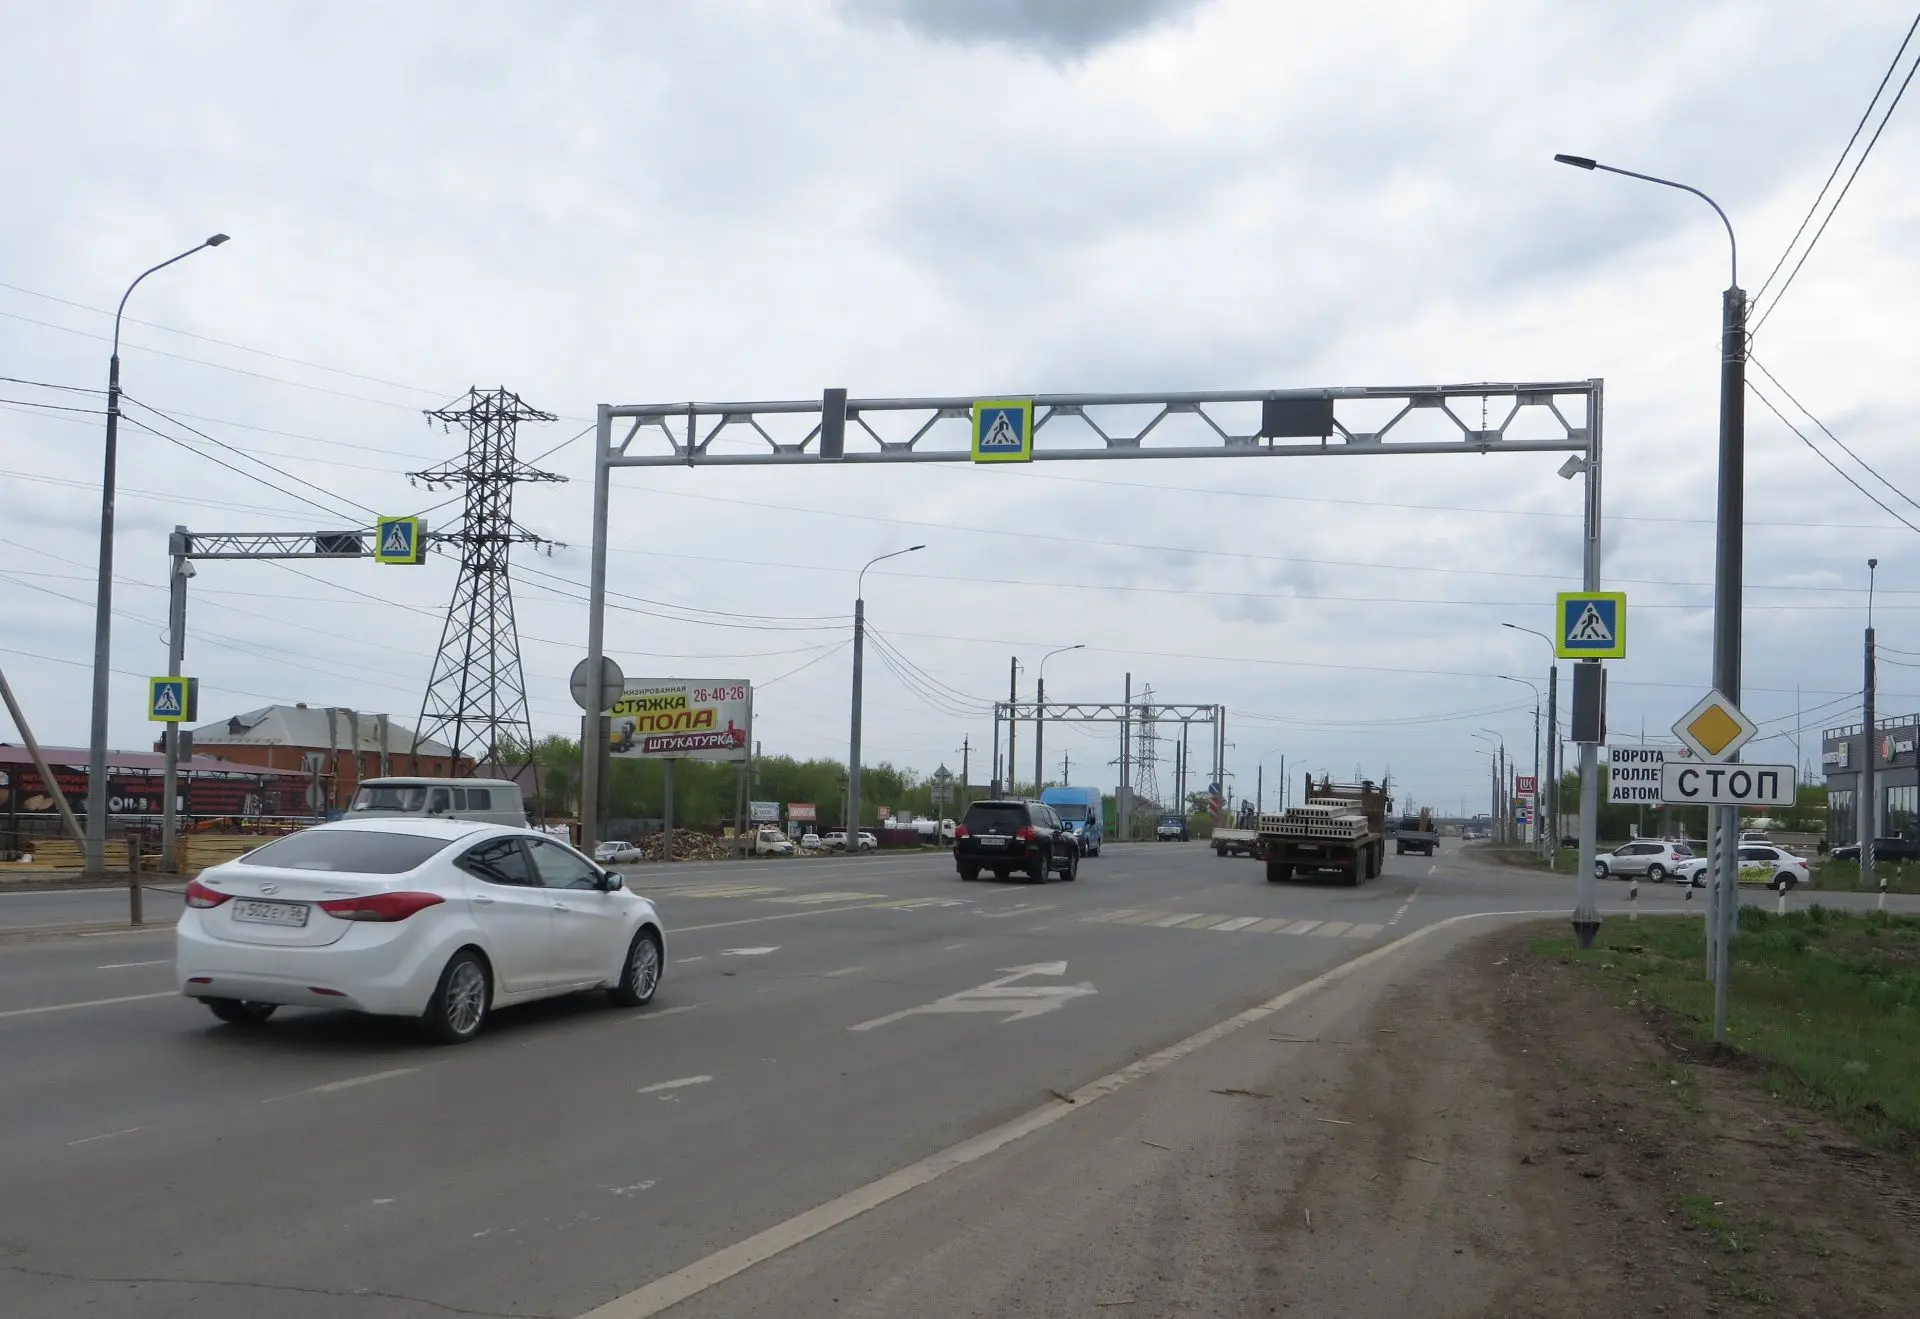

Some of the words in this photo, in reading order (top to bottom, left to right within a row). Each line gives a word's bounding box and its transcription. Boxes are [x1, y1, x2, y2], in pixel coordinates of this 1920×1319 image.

[694, 686, 745, 702] 26-40-26
[612, 696, 686, 714] СТЯЖКА
[639, 709, 713, 732] ПОЛА
[649, 734, 735, 750] ШТУКАТУРКА
[1612, 749, 1664, 763] ВОРОТА
[1612, 768, 1661, 781] РОЛЛЕ
[1678, 769, 1778, 799] СТОП
[1612, 786, 1660, 800] АВТОМ
